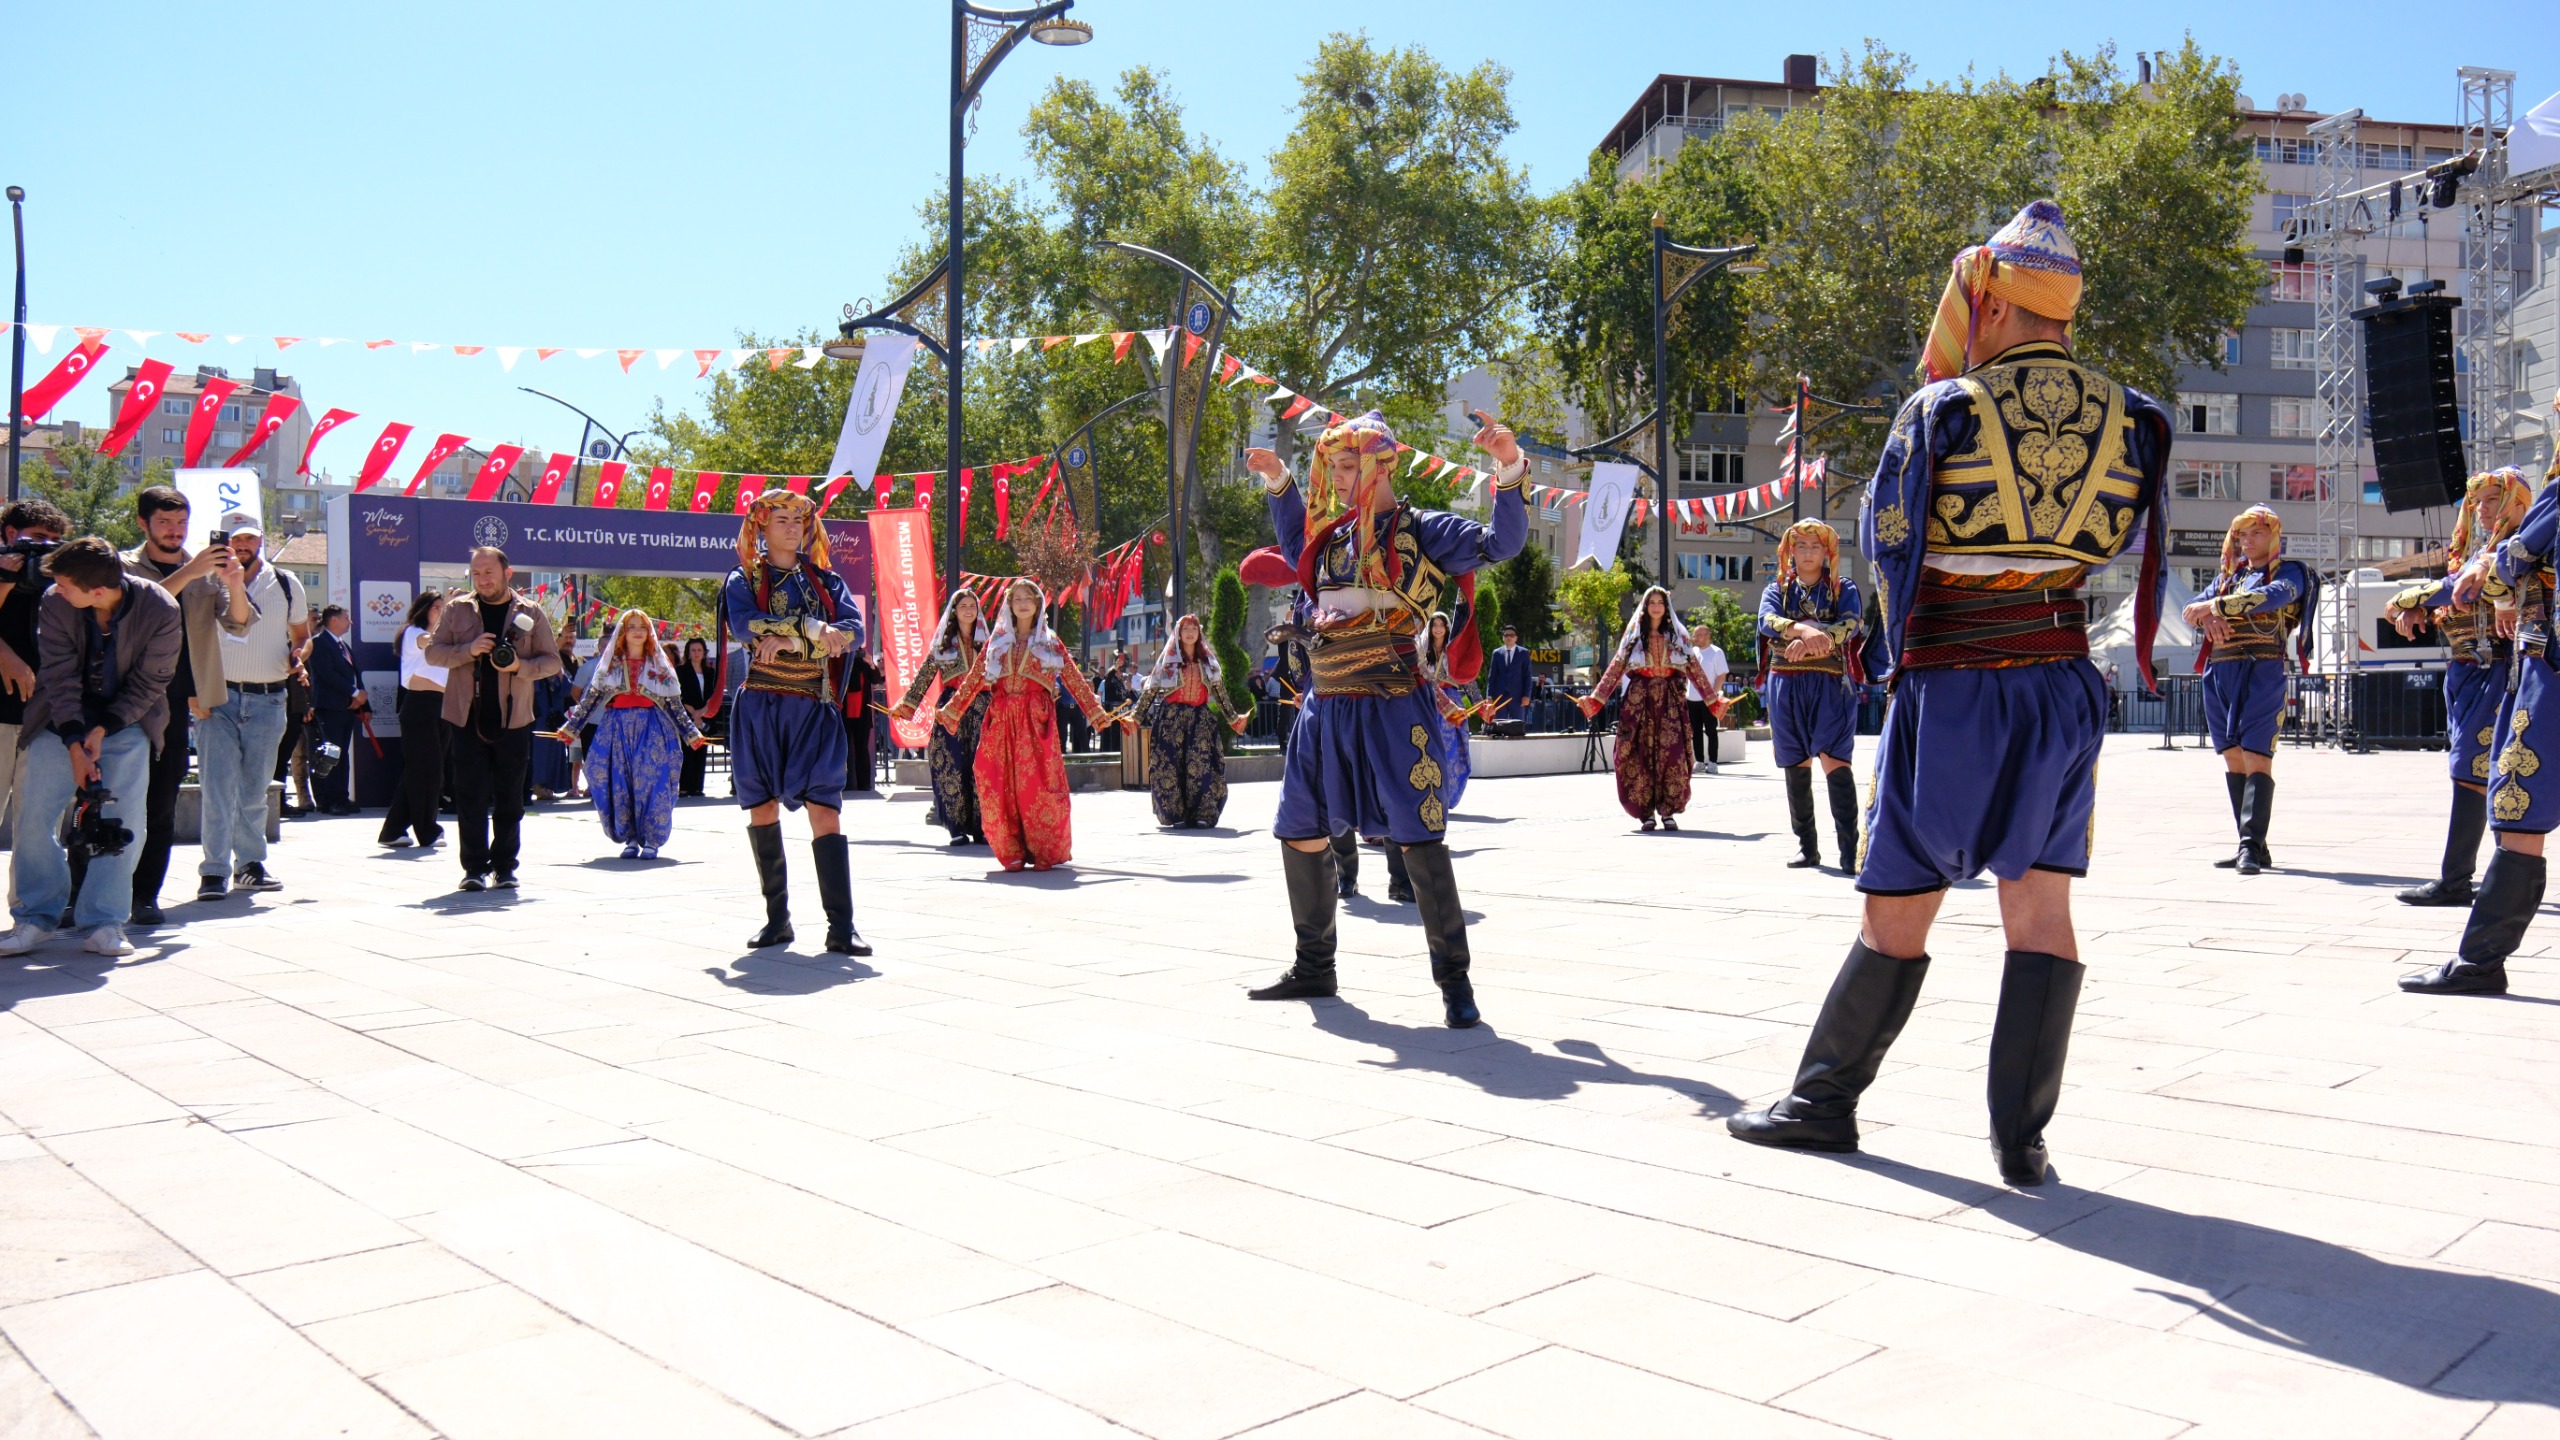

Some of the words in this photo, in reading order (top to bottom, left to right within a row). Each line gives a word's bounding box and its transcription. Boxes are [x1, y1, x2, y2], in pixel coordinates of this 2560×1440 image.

[524, 528, 551, 542] T.C.
[555, 527, 615, 545] KÜLTÜR
[618, 532, 637, 546] VE
[640, 532, 697, 548] TURİZM
[2185, 532, 2208, 540] ERDEM
[2211, 532, 2225, 541] HUK
[1530, 649, 1561, 663] AKSİ
